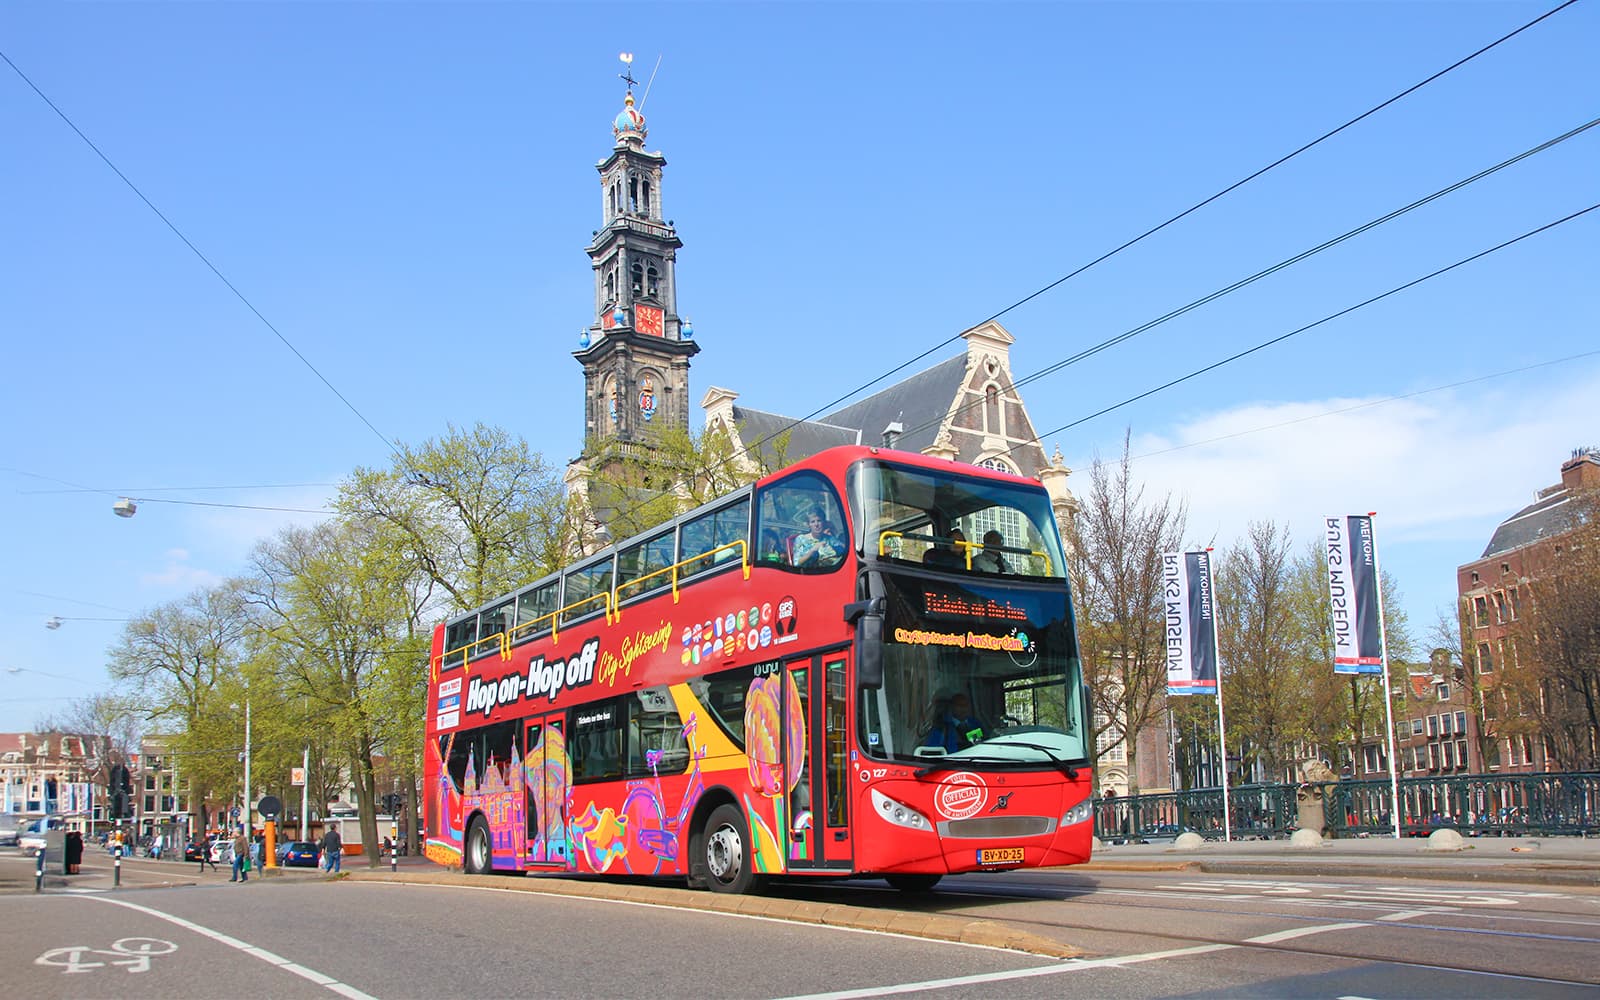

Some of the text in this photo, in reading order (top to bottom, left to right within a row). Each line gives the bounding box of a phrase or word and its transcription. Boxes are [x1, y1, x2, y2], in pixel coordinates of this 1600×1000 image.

[966, 631, 1023, 652] Amsterdam
[465, 677, 498, 716] Hop
[566, 640, 599, 686] off
[945, 787, 978, 803] OFFICIAL
